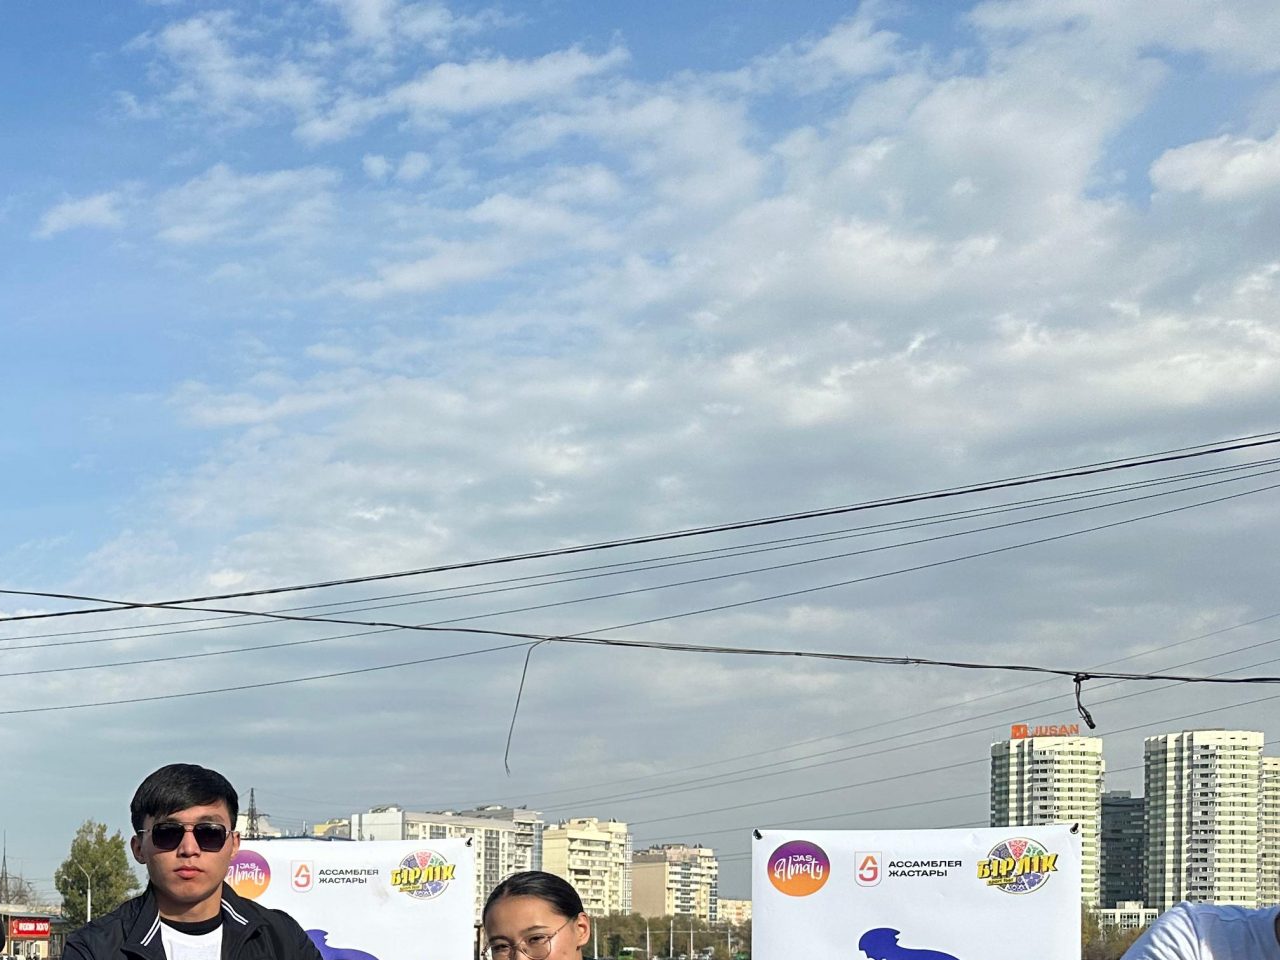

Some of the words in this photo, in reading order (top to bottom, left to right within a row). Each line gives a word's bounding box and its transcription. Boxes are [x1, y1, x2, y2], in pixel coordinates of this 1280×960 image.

[1035, 724, 1079, 736] JUSAN
[793, 854, 812, 862] JAS
[888, 860, 962, 868] АССАМБЛЕЯ
[318, 868, 379, 876] АССАМБЛЕЯ
[774, 855, 824, 882] Almaty
[977, 853, 1059, 879] БІРЛІК
[228, 863, 265, 887] Almaty
[391, 864, 456, 886] БІРЛІК
[888, 869, 948, 877] ЖАСТАРЫ
